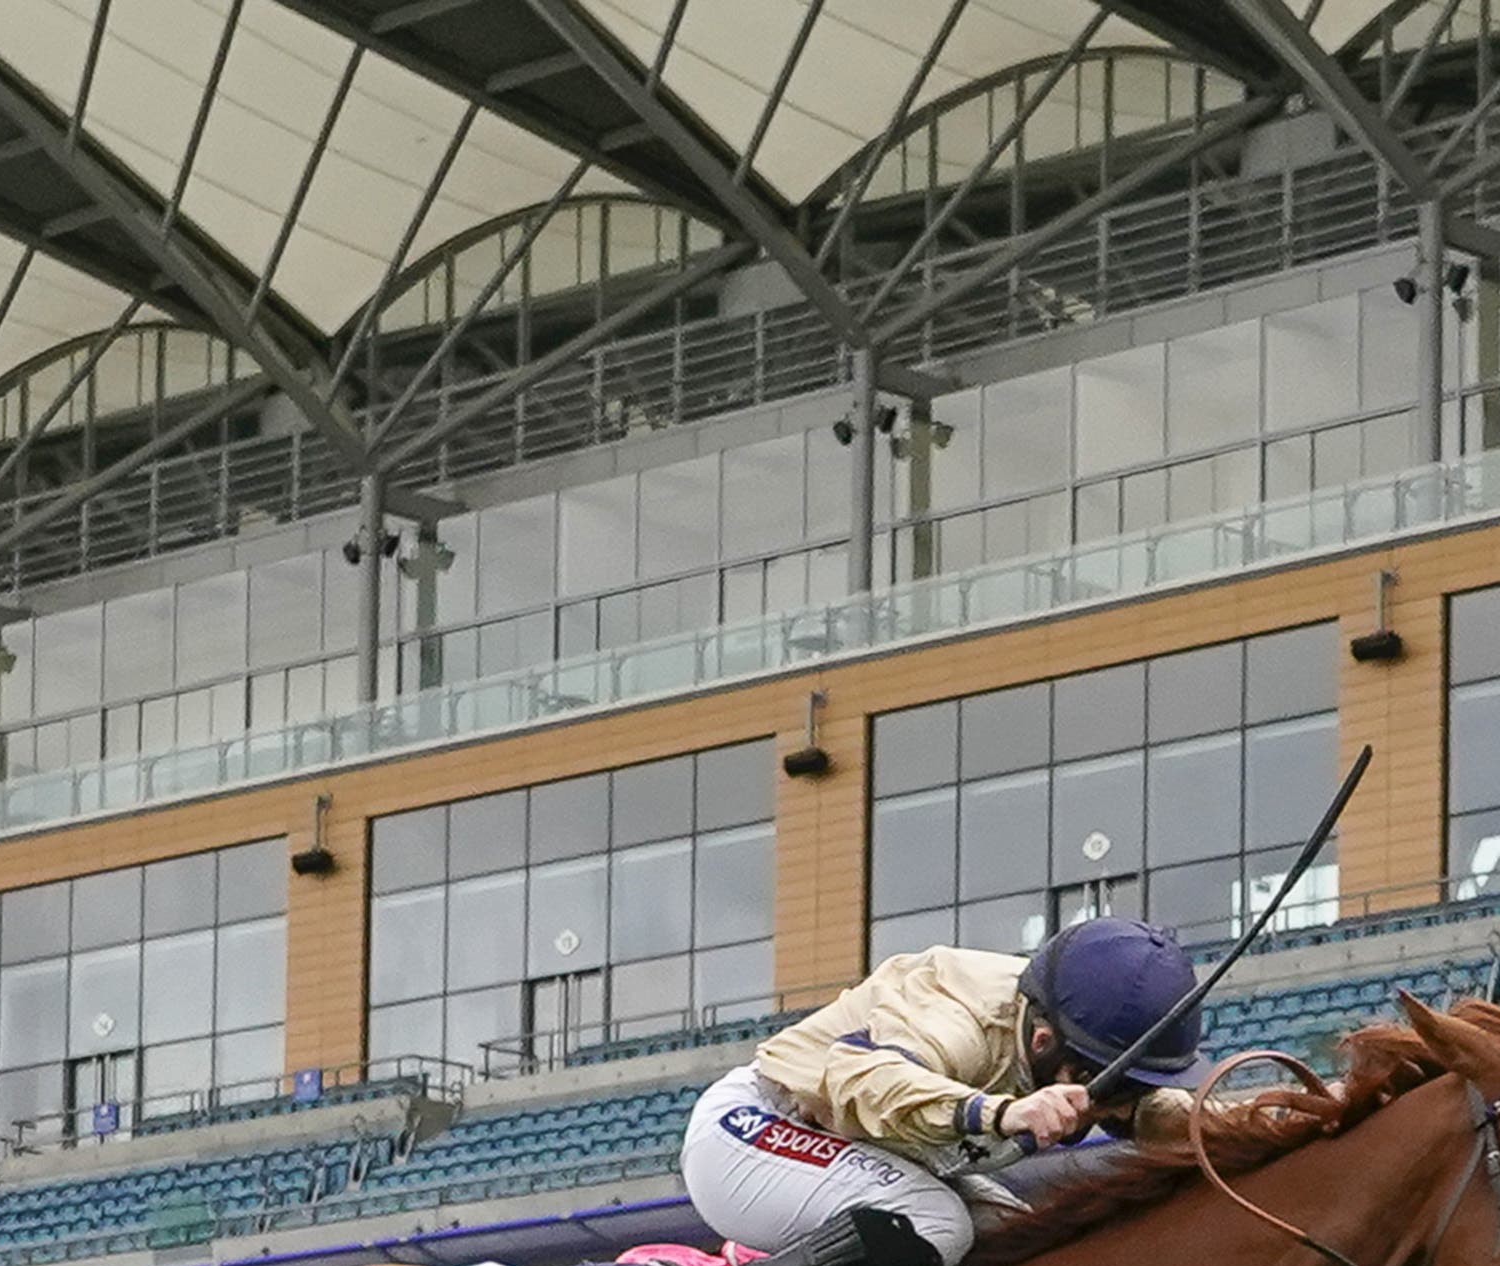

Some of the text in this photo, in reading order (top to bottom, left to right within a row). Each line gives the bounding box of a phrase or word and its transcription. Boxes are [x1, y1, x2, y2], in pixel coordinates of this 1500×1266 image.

[728, 1107, 904, 1186] sky sports racing
